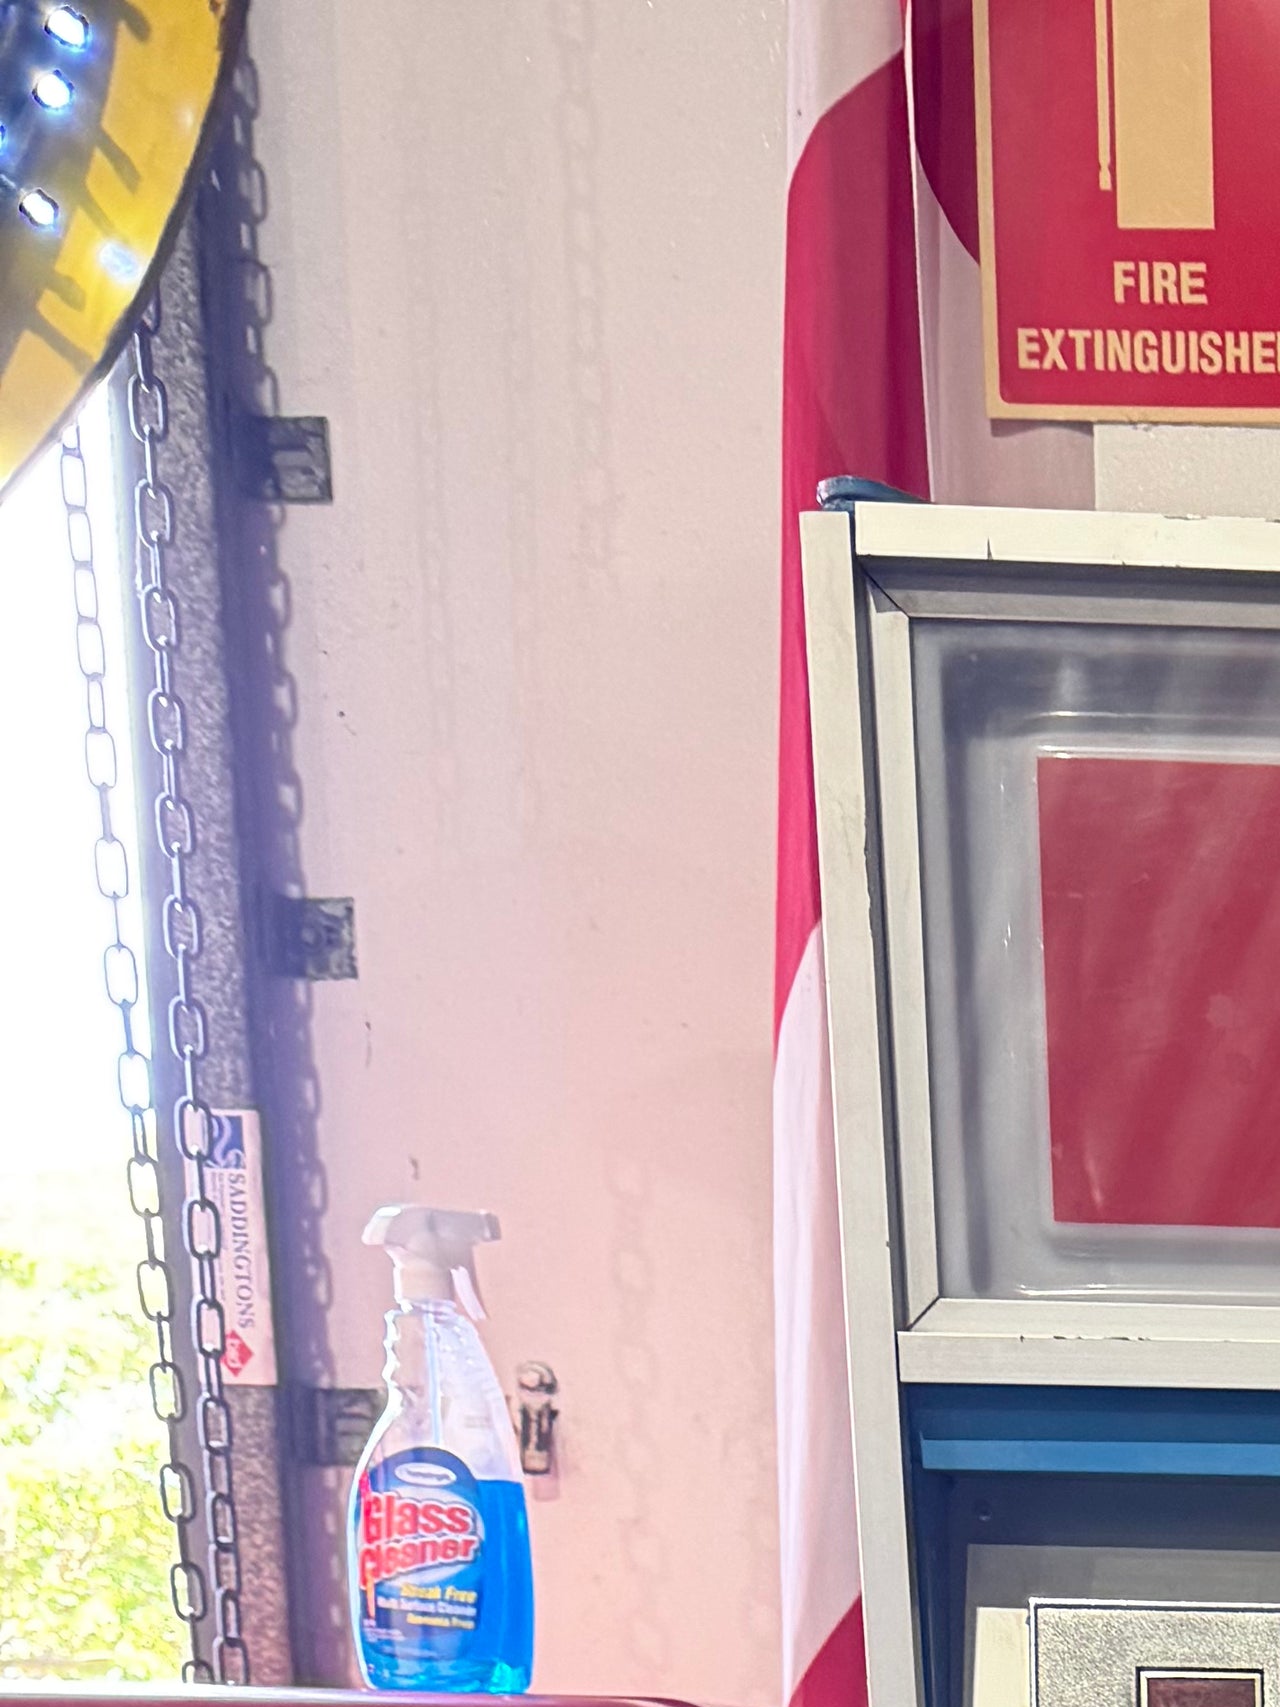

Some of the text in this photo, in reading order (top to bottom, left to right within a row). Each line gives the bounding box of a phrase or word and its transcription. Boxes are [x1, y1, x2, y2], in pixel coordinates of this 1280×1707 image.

[1113, 262, 1208, 304] FIRE
[228, 1173, 256, 1329] SADDINGTONS
[363, 1492, 473, 1543] Glass
